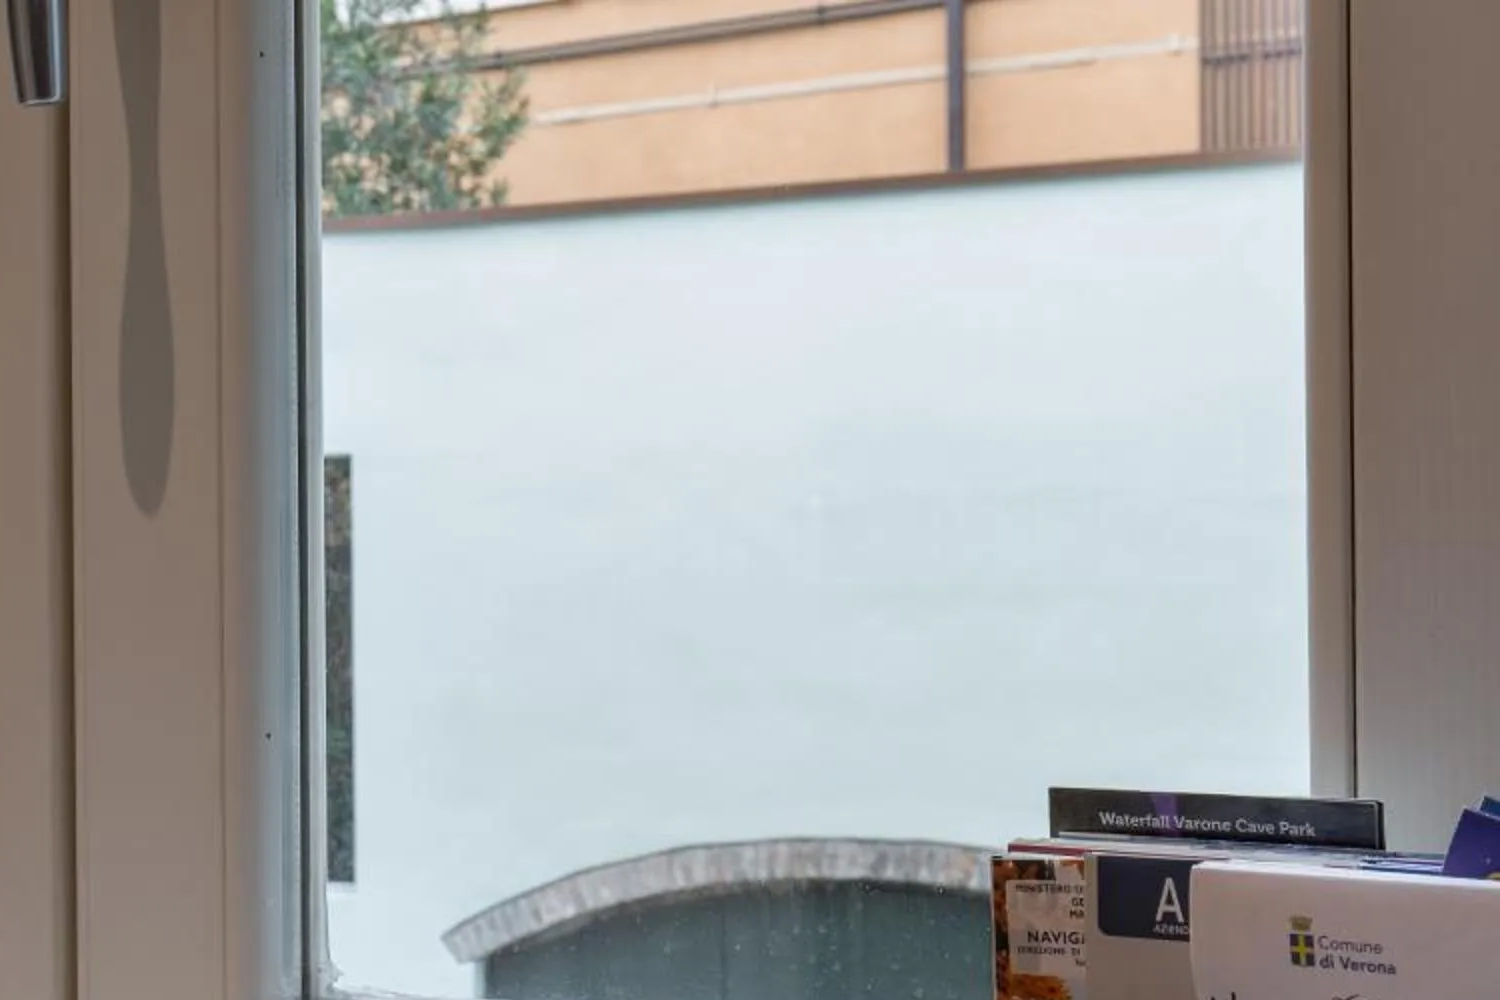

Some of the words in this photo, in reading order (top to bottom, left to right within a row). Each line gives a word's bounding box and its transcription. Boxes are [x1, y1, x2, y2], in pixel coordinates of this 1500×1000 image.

[1099, 811, 1170, 829] Waterfall
[1173, 815, 1231, 833] Varone
[1235, 818, 1275, 835] Cave
[1278, 820, 1316, 838] Park
[1155, 877, 1185, 923] A
[1026, 930, 1085, 945] NAVIG
[1317, 935, 1383, 955] Comune
[1319, 955, 1335, 971] di
[1338, 957, 1397, 977] Verona
